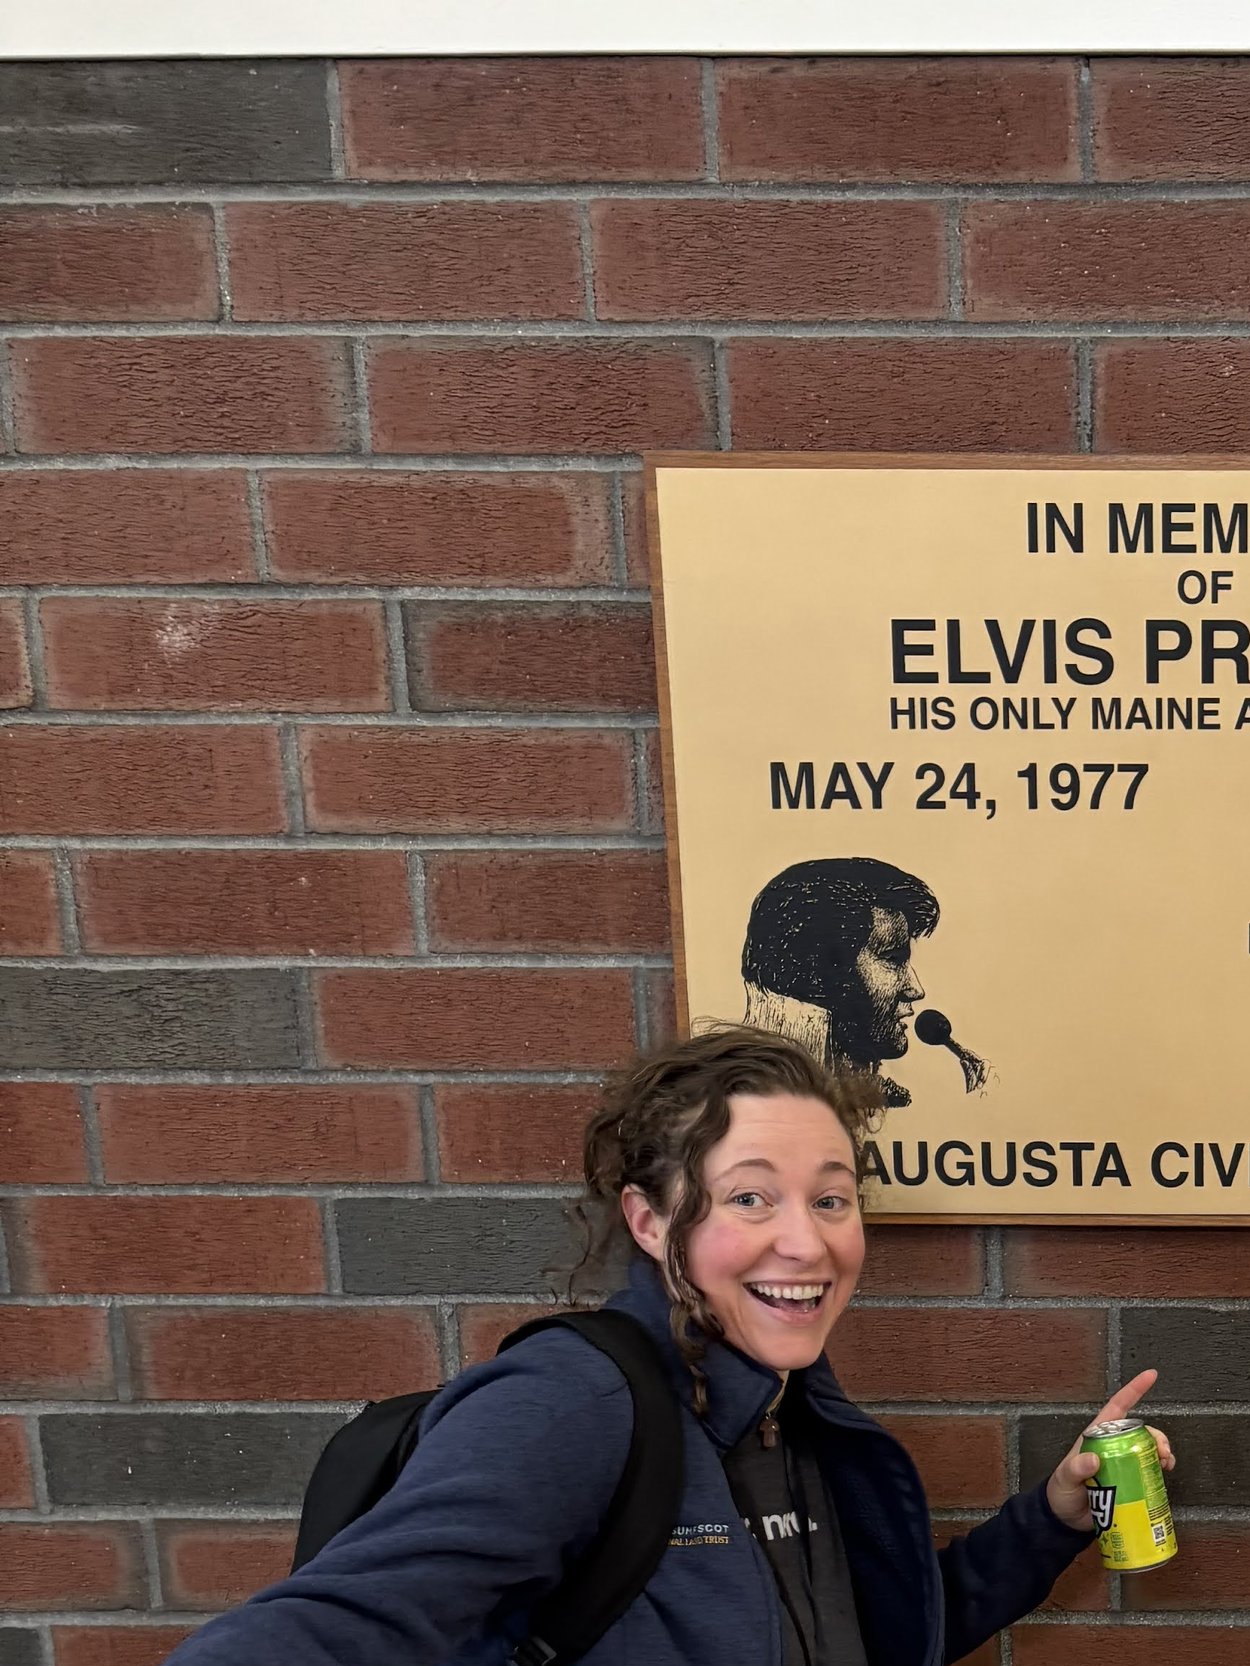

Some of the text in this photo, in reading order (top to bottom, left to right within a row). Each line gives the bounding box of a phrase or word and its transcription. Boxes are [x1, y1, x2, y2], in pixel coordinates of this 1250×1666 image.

[1027, 502, 1084, 555] IN
[1177, 569, 1234, 605] OF
[891, 617, 1115, 686] ELVIS
[890, 696, 956, 731] HIS
[969, 696, 1077, 731] ONLY
[1091, 696, 1221, 731] MAINE
[770, 761, 1149, 820] MAY 24, 1977
[857, 1140, 1132, 1188] AUGUSTA
[703, 1535, 729, 1544] TRUST
